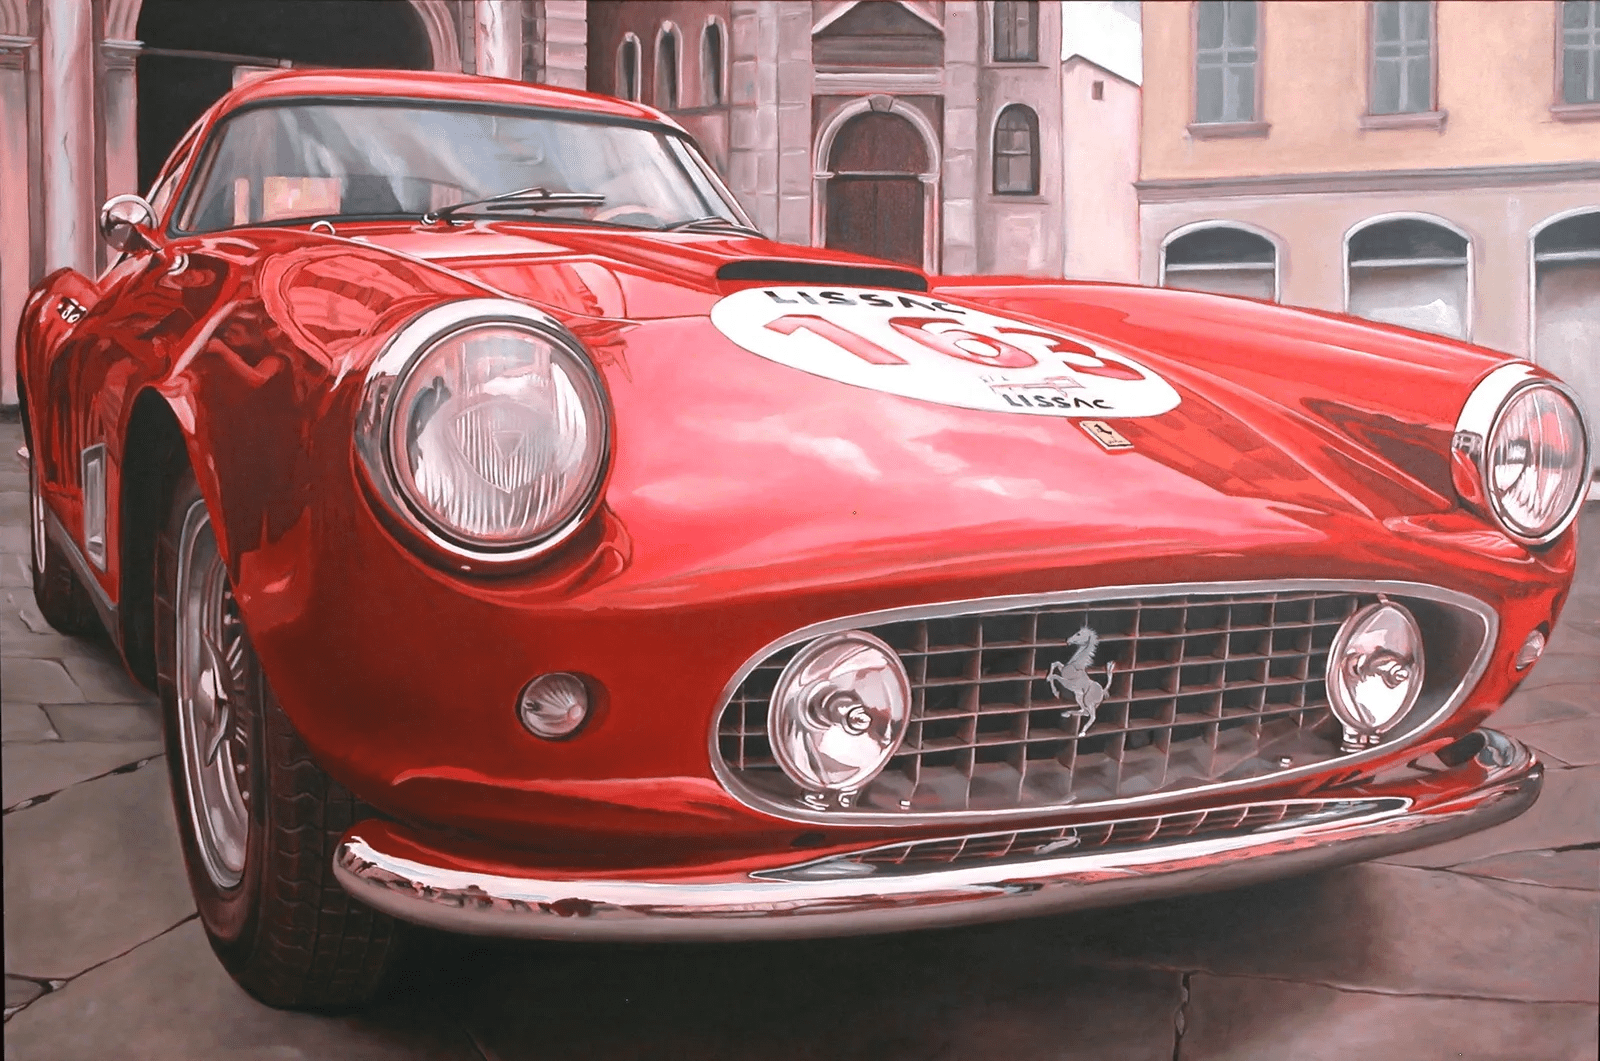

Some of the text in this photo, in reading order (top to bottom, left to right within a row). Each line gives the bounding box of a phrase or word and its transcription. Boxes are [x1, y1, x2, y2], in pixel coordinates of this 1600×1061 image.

[763, 290, 967, 315] LISSAC
[762, 313, 1146, 381] 163
[1001, 393, 1116, 410] LISSAC
